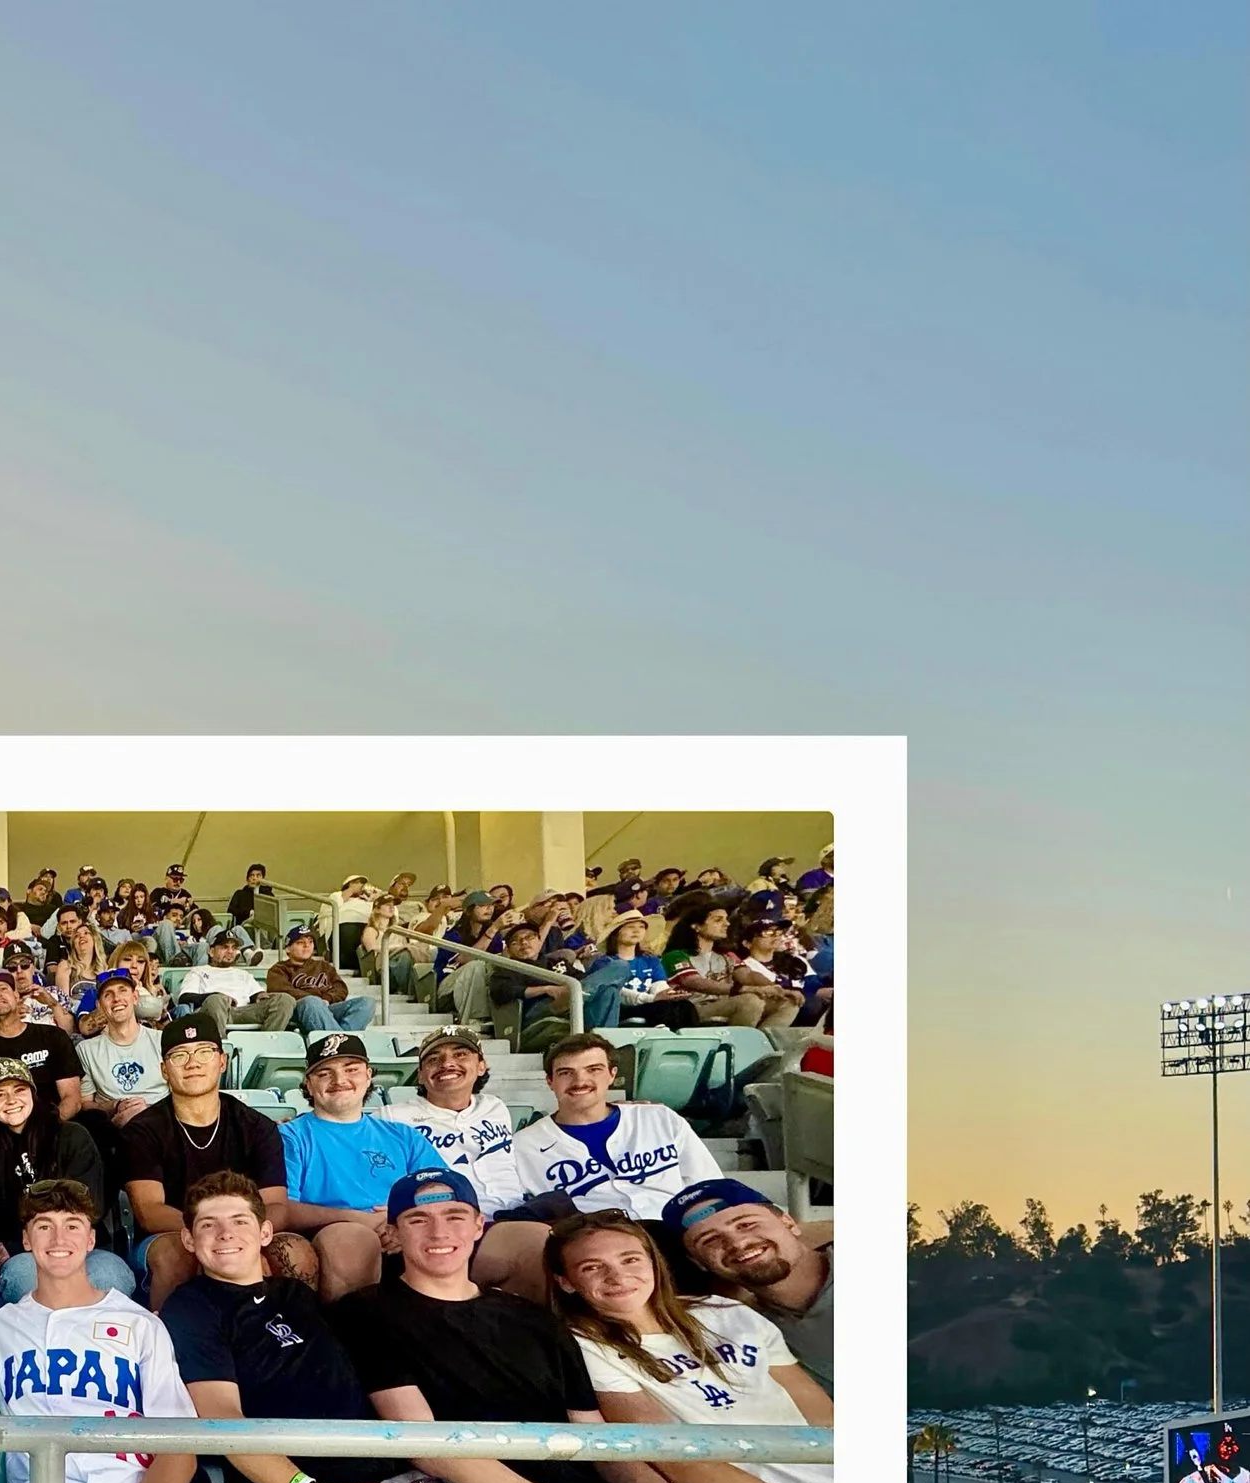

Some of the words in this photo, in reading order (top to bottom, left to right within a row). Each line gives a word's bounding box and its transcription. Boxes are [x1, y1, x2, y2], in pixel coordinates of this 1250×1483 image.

[21, 1050, 49, 1064] CAMP
[546, 1143, 678, 1191] Dodgers
[4, 1349, 145, 1416] JAPAN
[690, 1380, 736, 1407] LA
